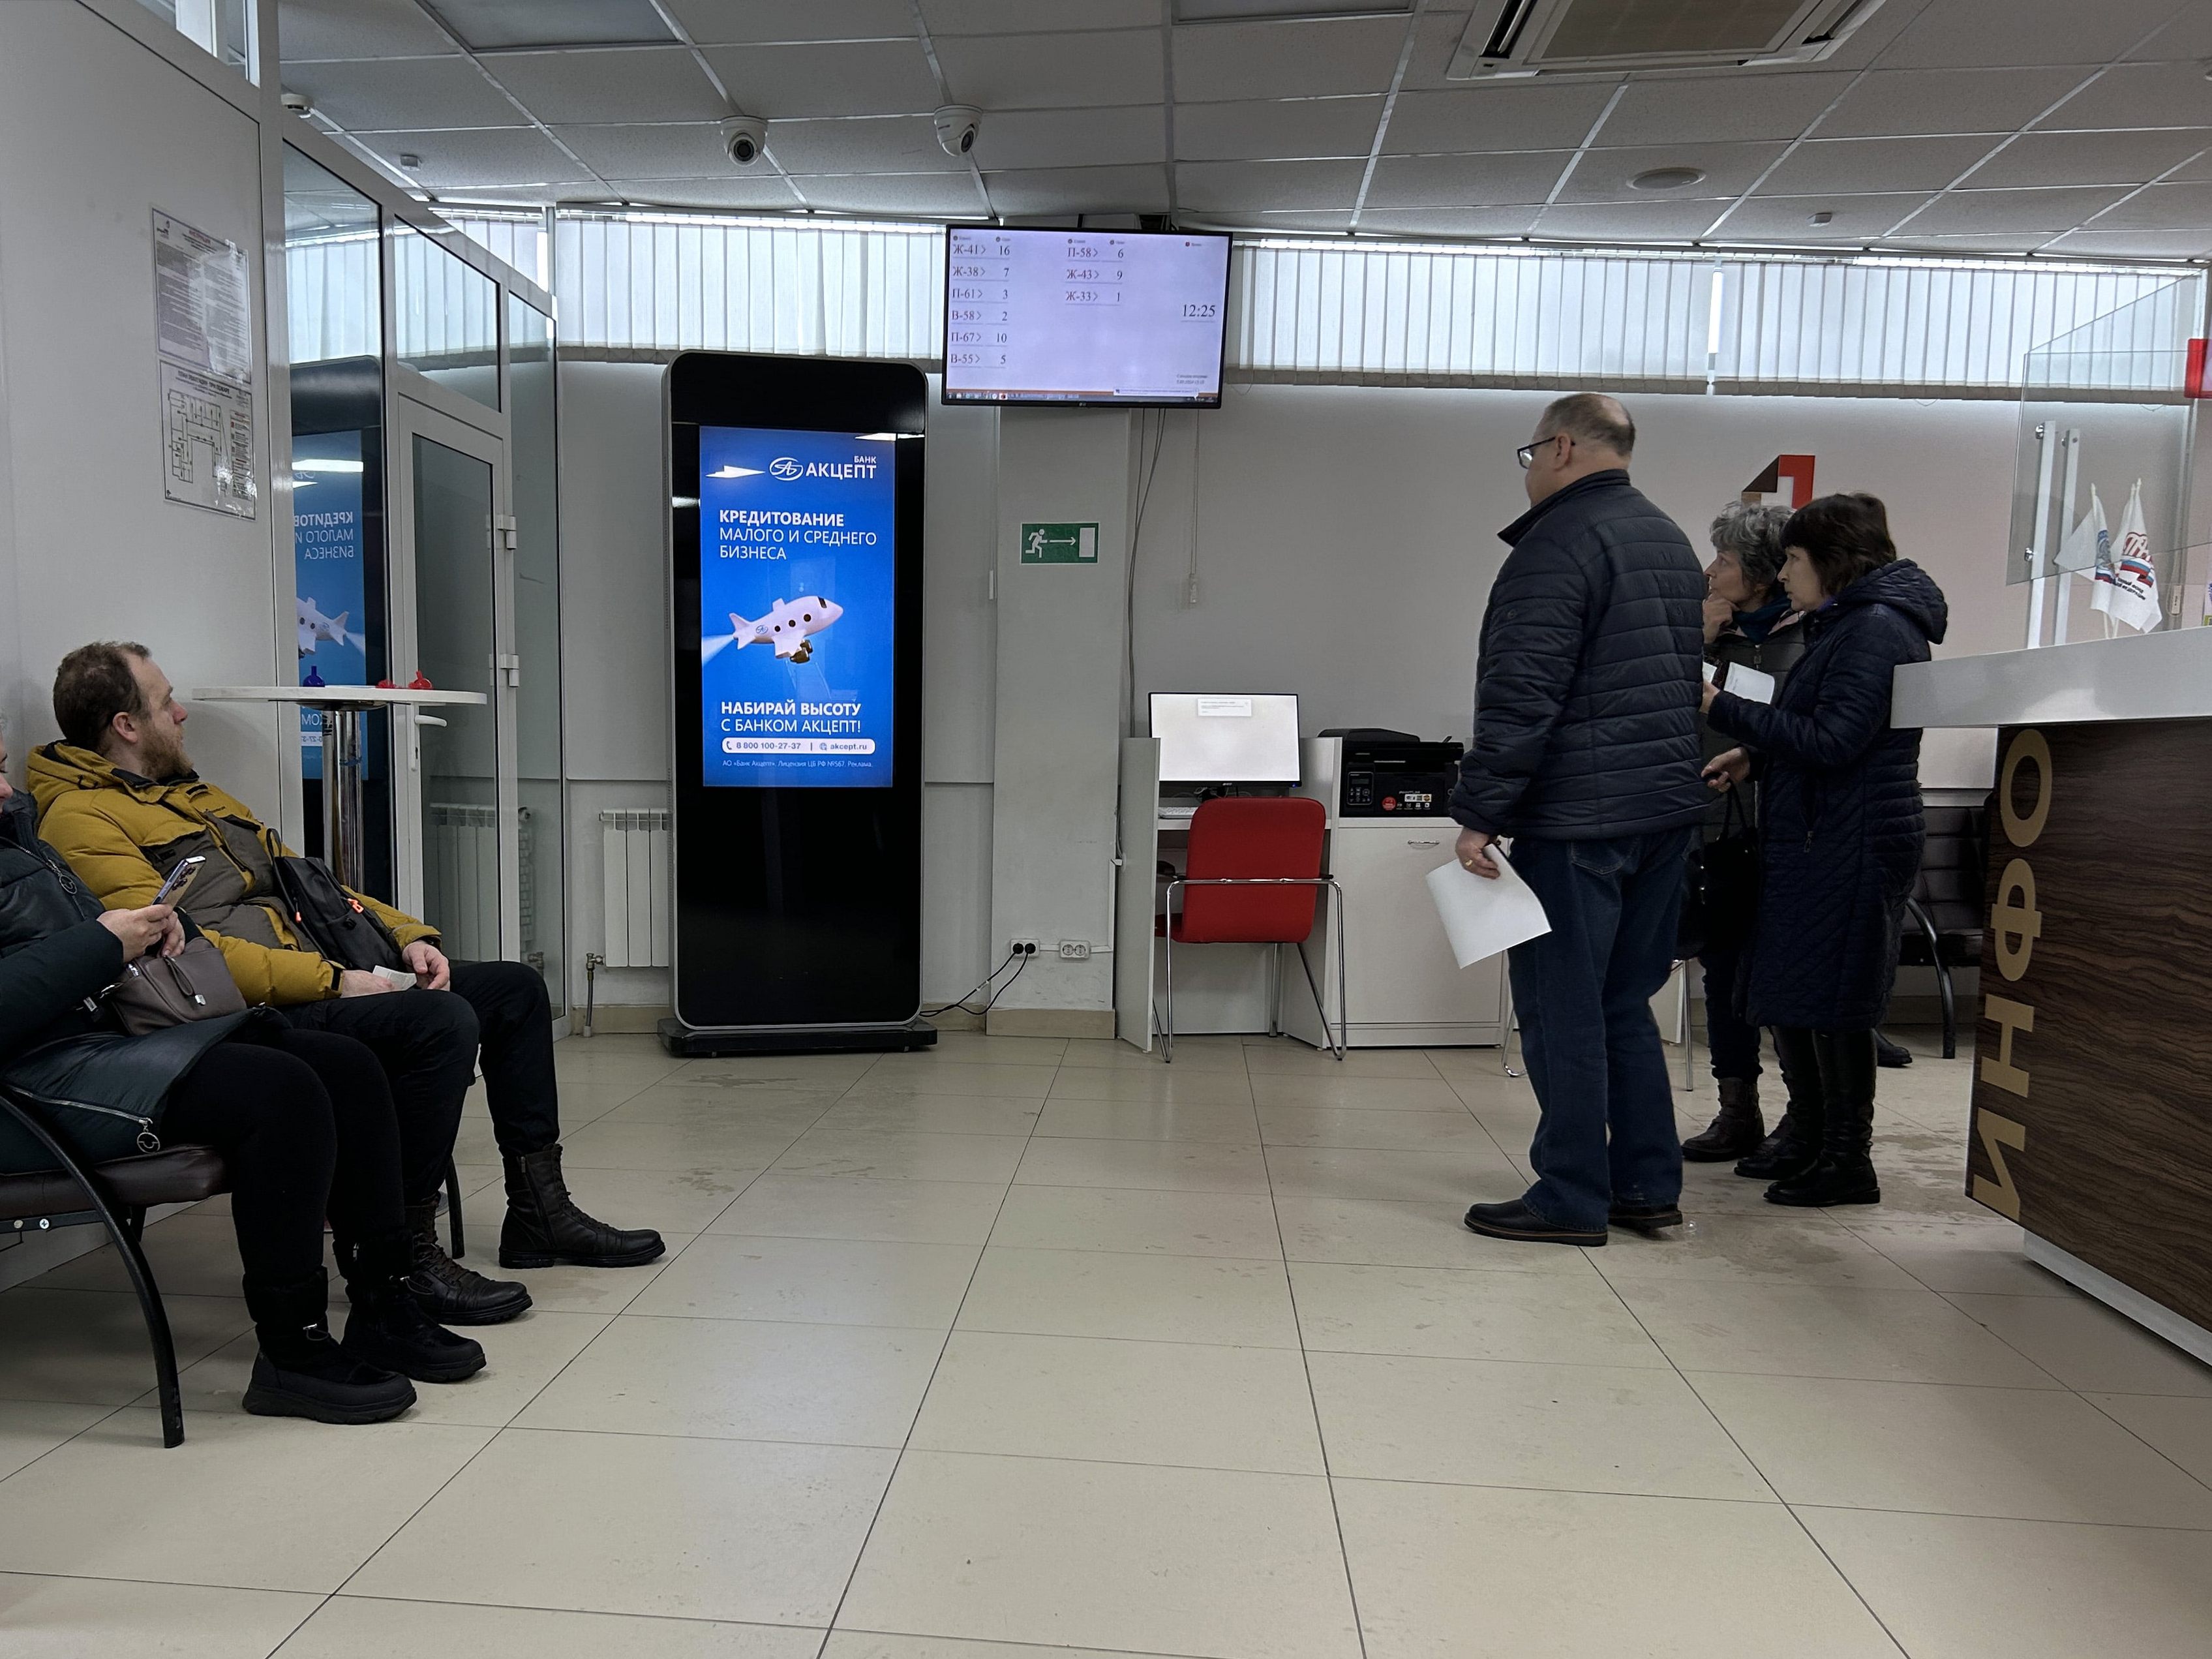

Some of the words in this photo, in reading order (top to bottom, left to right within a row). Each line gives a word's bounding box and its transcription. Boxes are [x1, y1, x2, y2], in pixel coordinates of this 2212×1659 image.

[1000, 245, 1010, 255] 16
[1117, 249, 1124, 258] 6
[1004, 267, 1009, 277] 7
[1117, 270, 1123, 280] 9
[1003, 289, 1008, 299] 3
[1117, 292, 1121, 302] 1
[1183, 304, 1216, 317] 12:25
[1002, 311, 1008, 321] 2
[997, 333, 1007, 343] 10
[1000, 355, 1006, 364] 5
[854, 455, 877, 464] БАНК
[806, 463, 877, 480] АКЦЕПТ
[720, 510, 845, 526] КРЕДИТОВАНИЕ
[720, 527, 784, 542] МАЛОГО
[789, 529, 799, 543] И
[804, 530, 877, 547] СРЕДНЕГО
[720, 545, 787, 560] БИЗНЕСА
[721, 699, 796, 715] НАБИРАЙ
[800, 703, 861, 716] ВЫСОТУ
[721, 718, 731, 731] С
[735, 718, 798, 733] БАНКОМ
[801, 720, 861, 735] АКЦЕПТ!
[830, 742, 868, 752] akcept.ru
[1973, 728, 2053, 1222] ИНФО
